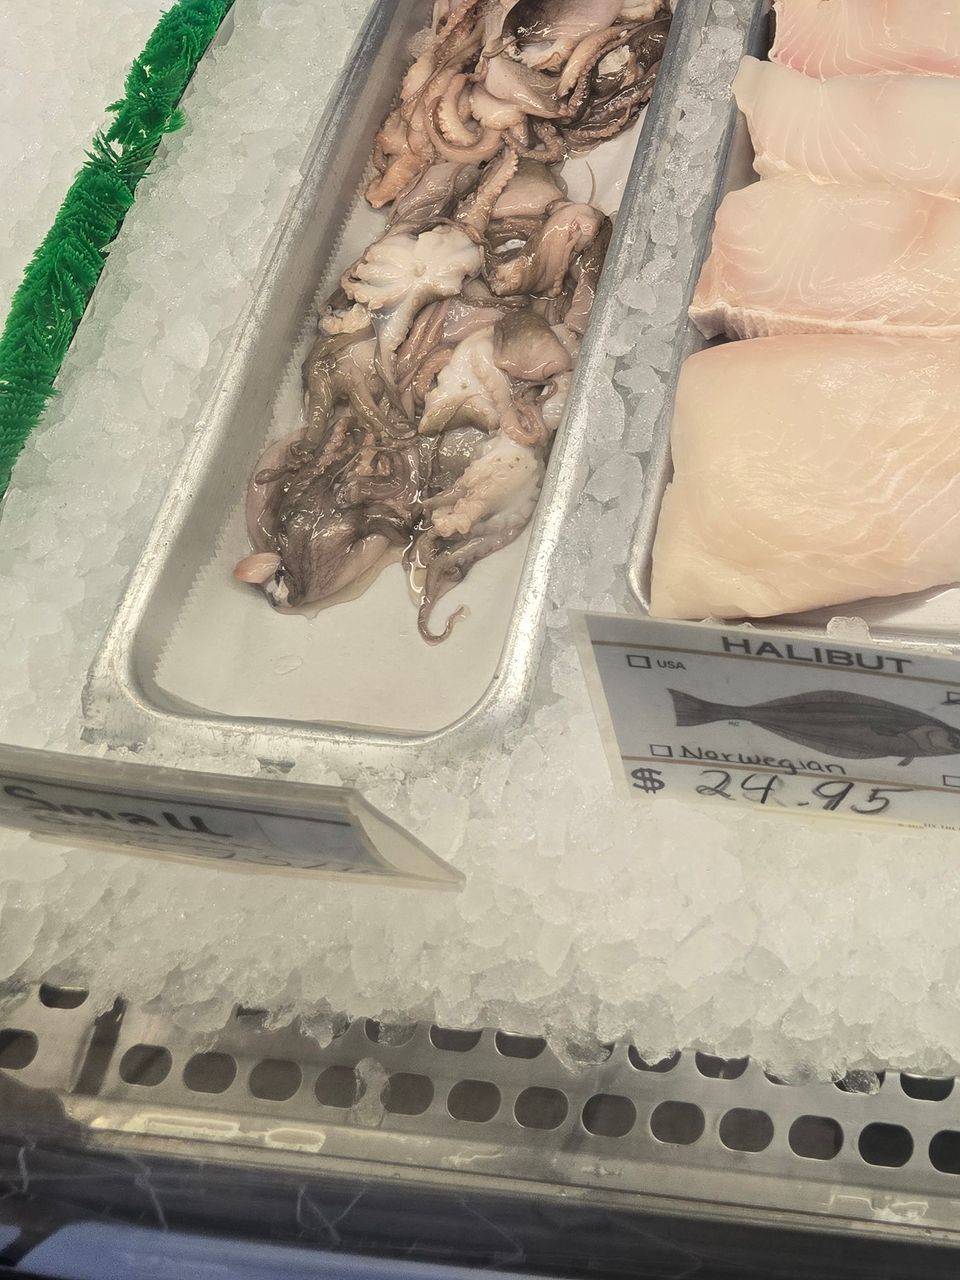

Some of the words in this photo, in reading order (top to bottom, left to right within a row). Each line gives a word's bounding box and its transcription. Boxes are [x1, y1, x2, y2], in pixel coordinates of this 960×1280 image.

[656, 659, 686, 670] USA
[721, 636, 912, 673] HALIBUT
[679, 745, 847, 776] Norwegian
[630, 767, 665, 794] $
[696, 770, 914, 814] 24.95
